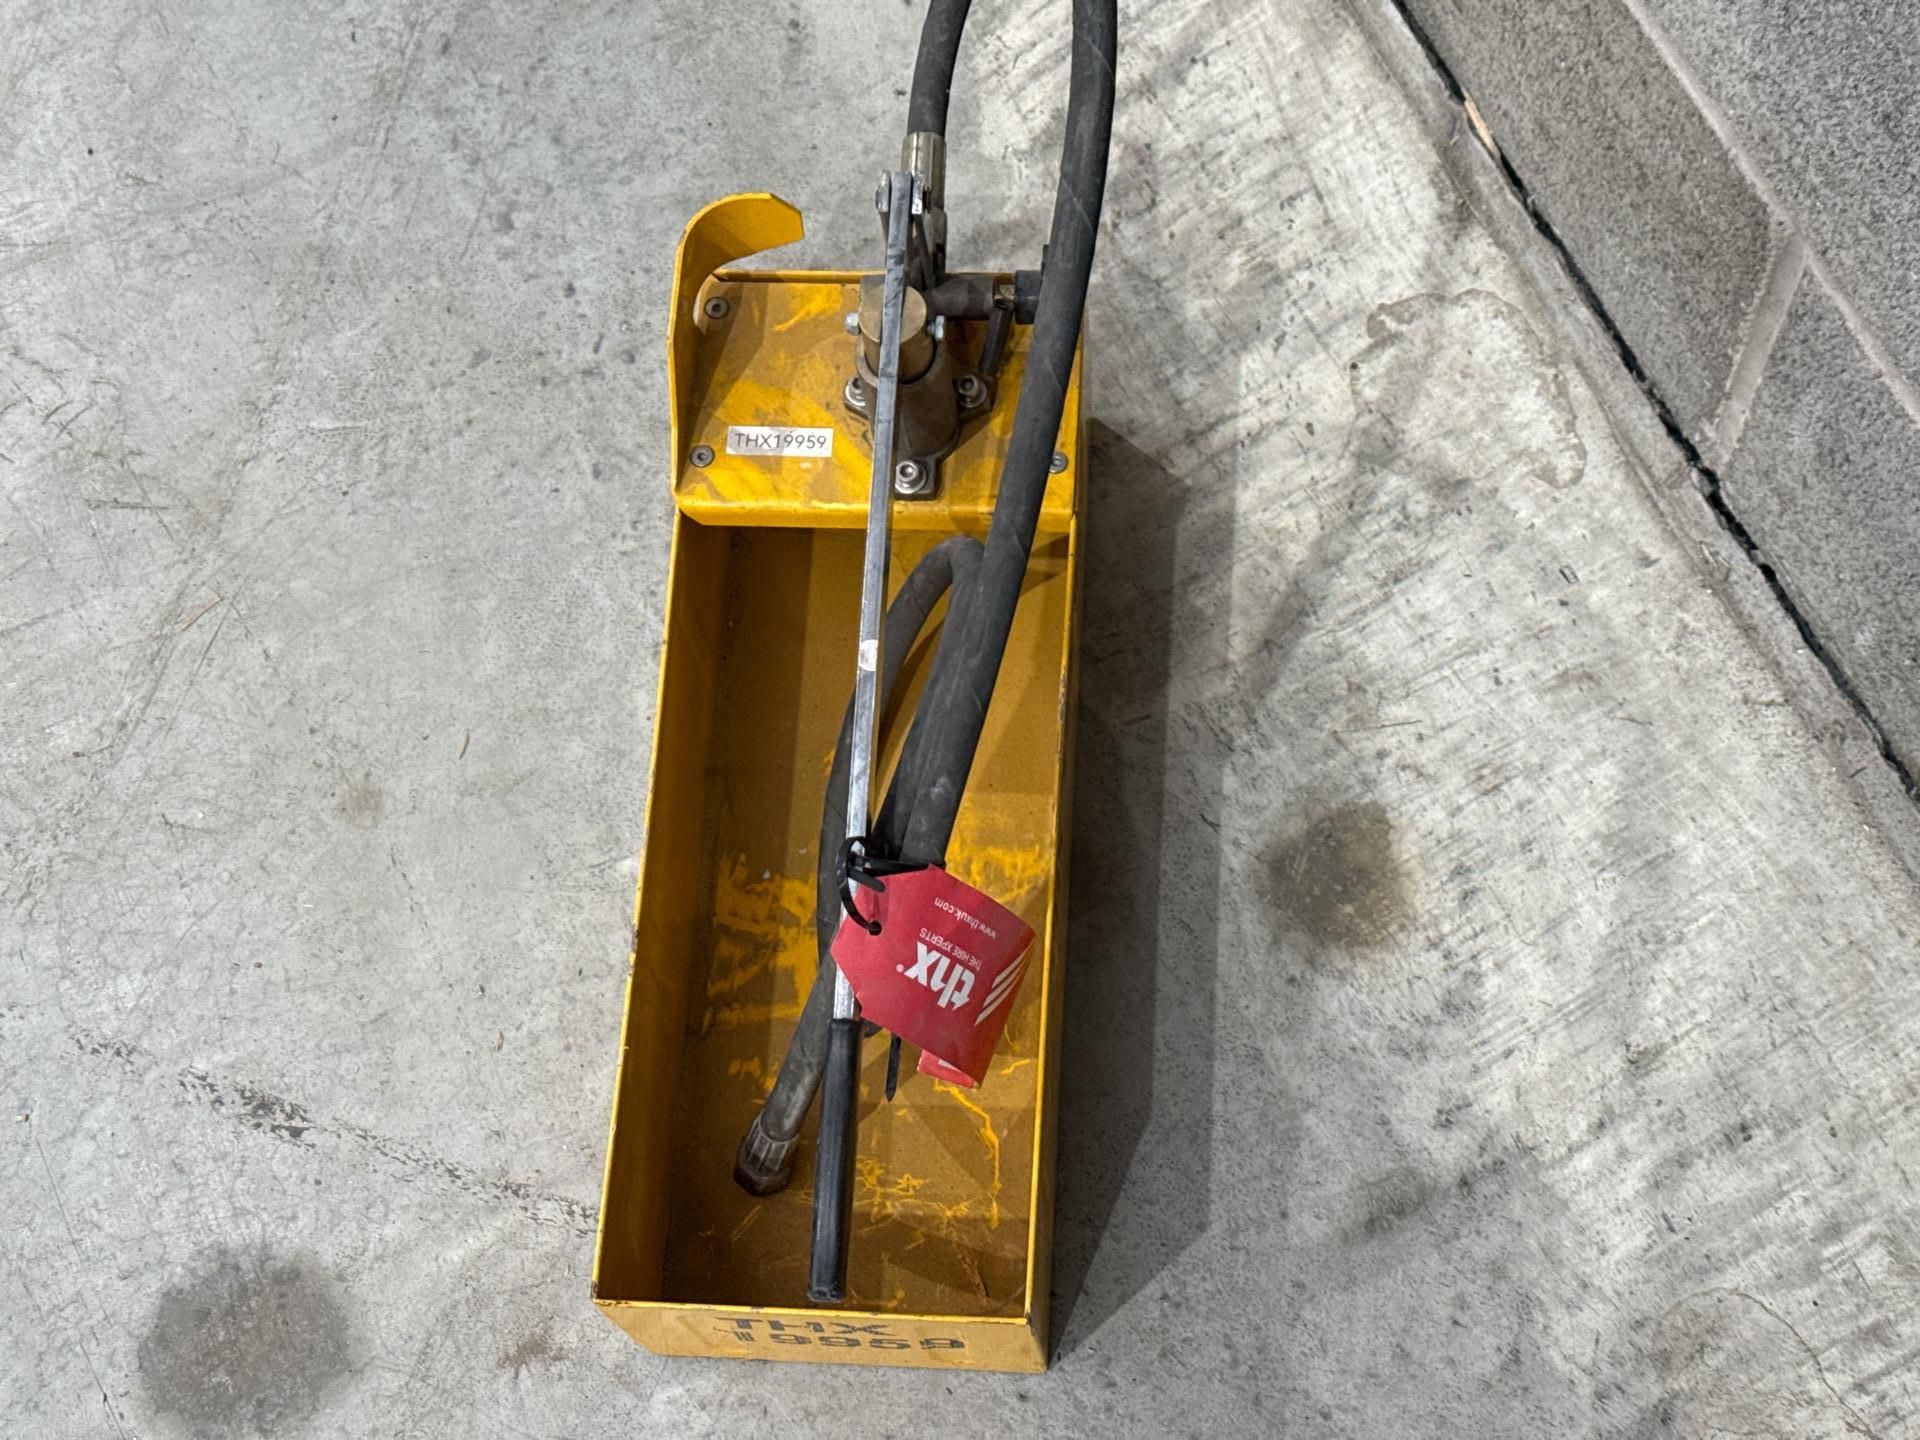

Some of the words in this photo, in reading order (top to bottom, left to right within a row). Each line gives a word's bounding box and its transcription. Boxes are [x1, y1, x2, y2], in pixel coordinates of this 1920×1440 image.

[734, 432, 827, 449] THX19959
[934, 897, 996, 939] www.thxuk.com
[919, 927, 953, 953] XPERTS
[951, 945, 970, 962] HIRE
[968, 956, 983, 971] THE
[714, 1317, 896, 1336] THX
[713, 1326, 965, 1350] 19959
